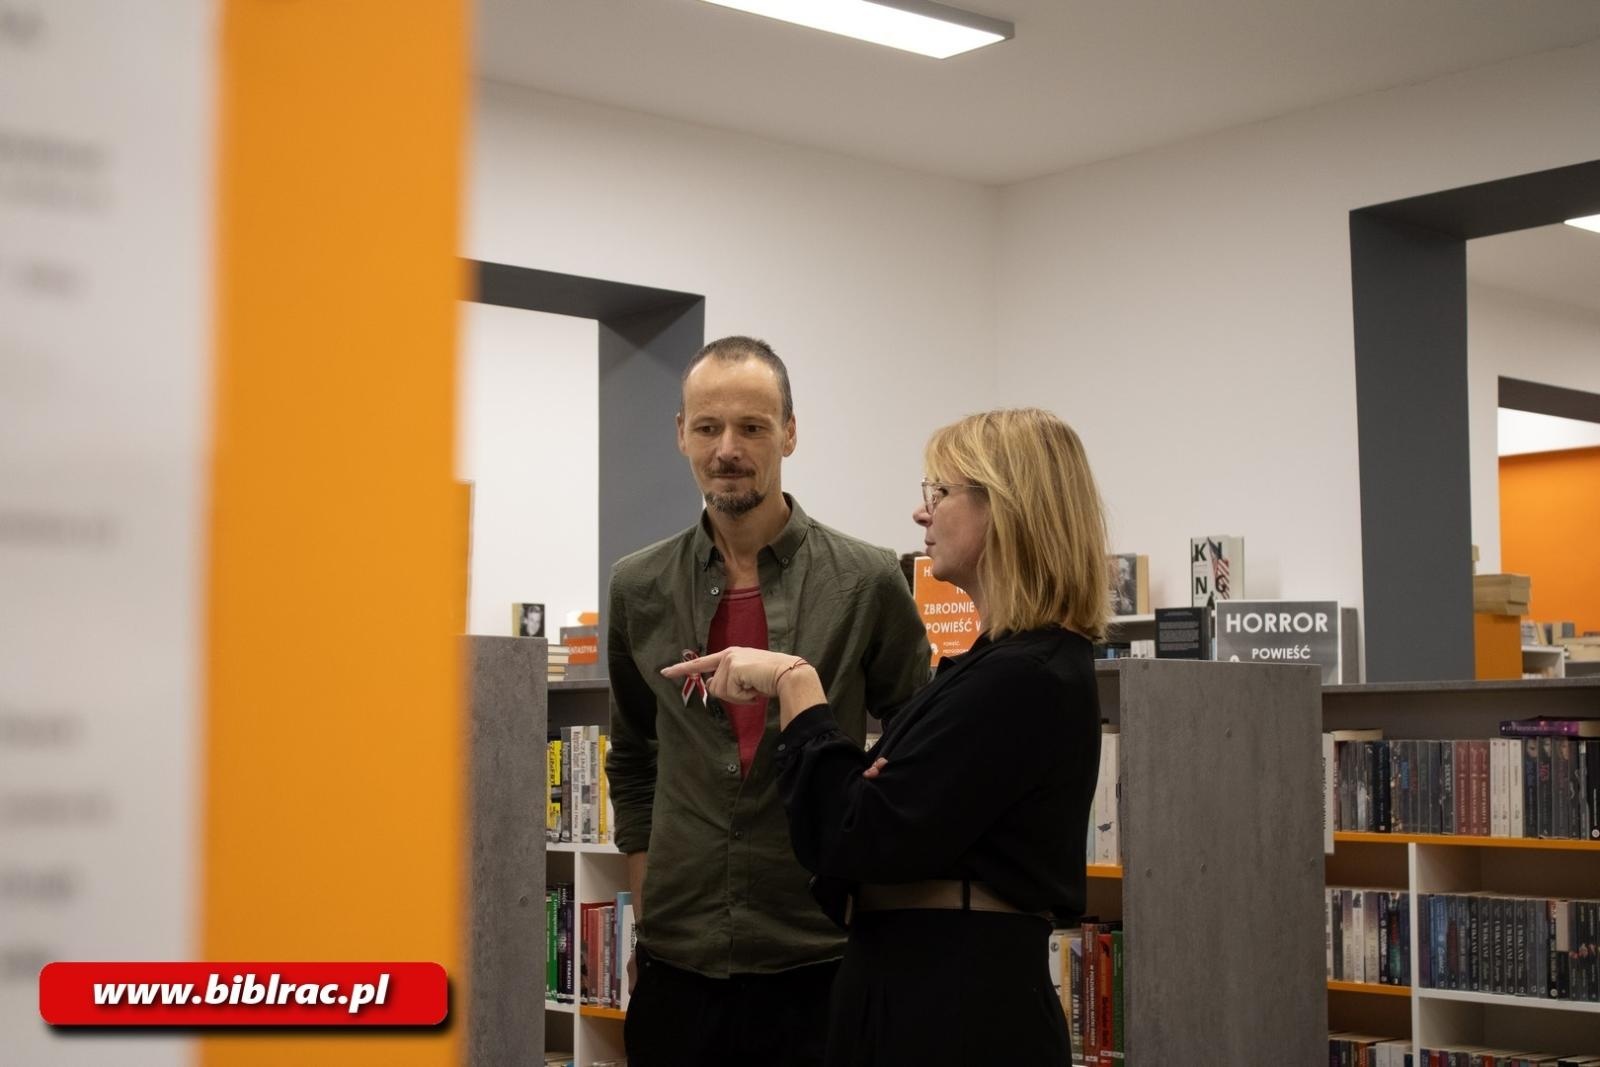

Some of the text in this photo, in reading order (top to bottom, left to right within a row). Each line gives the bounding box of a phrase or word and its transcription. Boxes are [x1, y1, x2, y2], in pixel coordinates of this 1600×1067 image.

[923, 601, 975, 616] ZBRODNIE
[925, 618, 973, 634] POWIEŚĆ
[1226, 612, 1329, 633] HORROR
[1251, 644, 1312, 660] POWIEŚĆ
